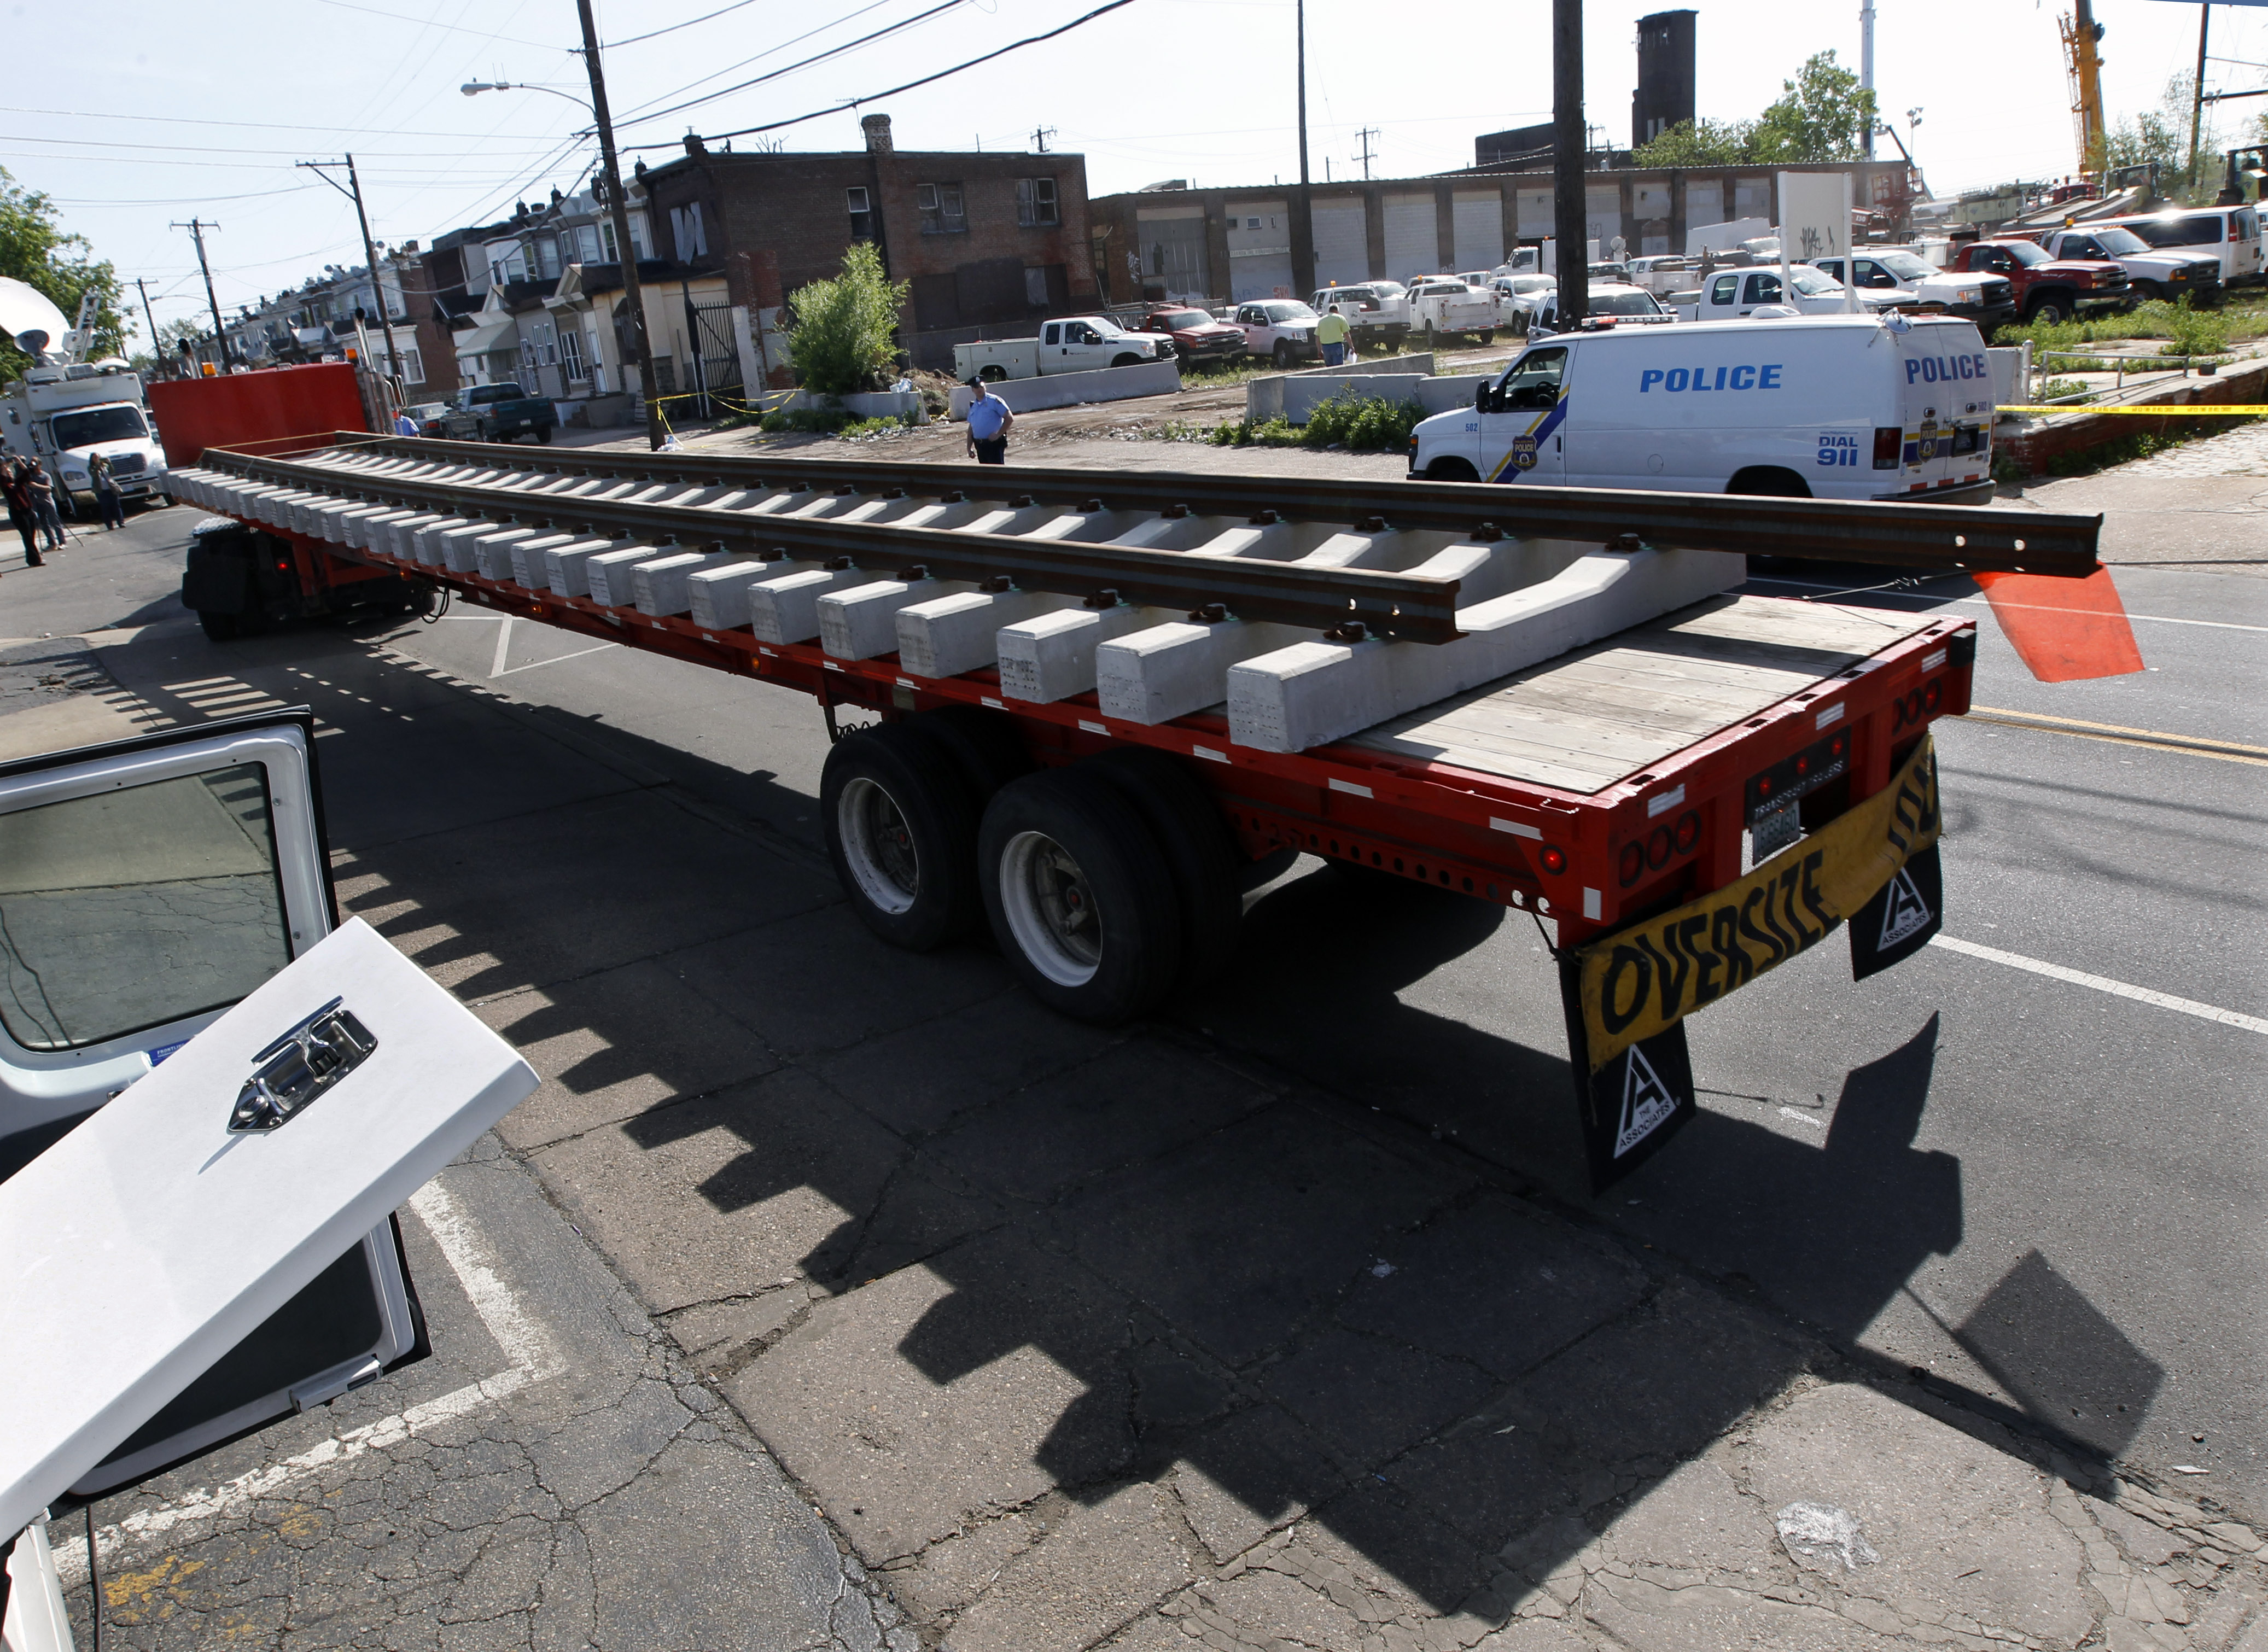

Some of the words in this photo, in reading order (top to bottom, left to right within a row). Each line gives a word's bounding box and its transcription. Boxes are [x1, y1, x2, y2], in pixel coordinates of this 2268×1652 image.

[1640, 364, 1783, 393] POLICE
[1904, 354, 1987, 384] POLICE
[1465, 423, 1478, 432] 502
[1514, 443, 1534, 452] POLICE
[1818, 436, 1858, 447] DIAL
[1816, 448, 1858, 466] 911
[1601, 849, 1841, 1035] OVERSIZE
[1619, 1101, 1670, 1149] ASSOCIATES
